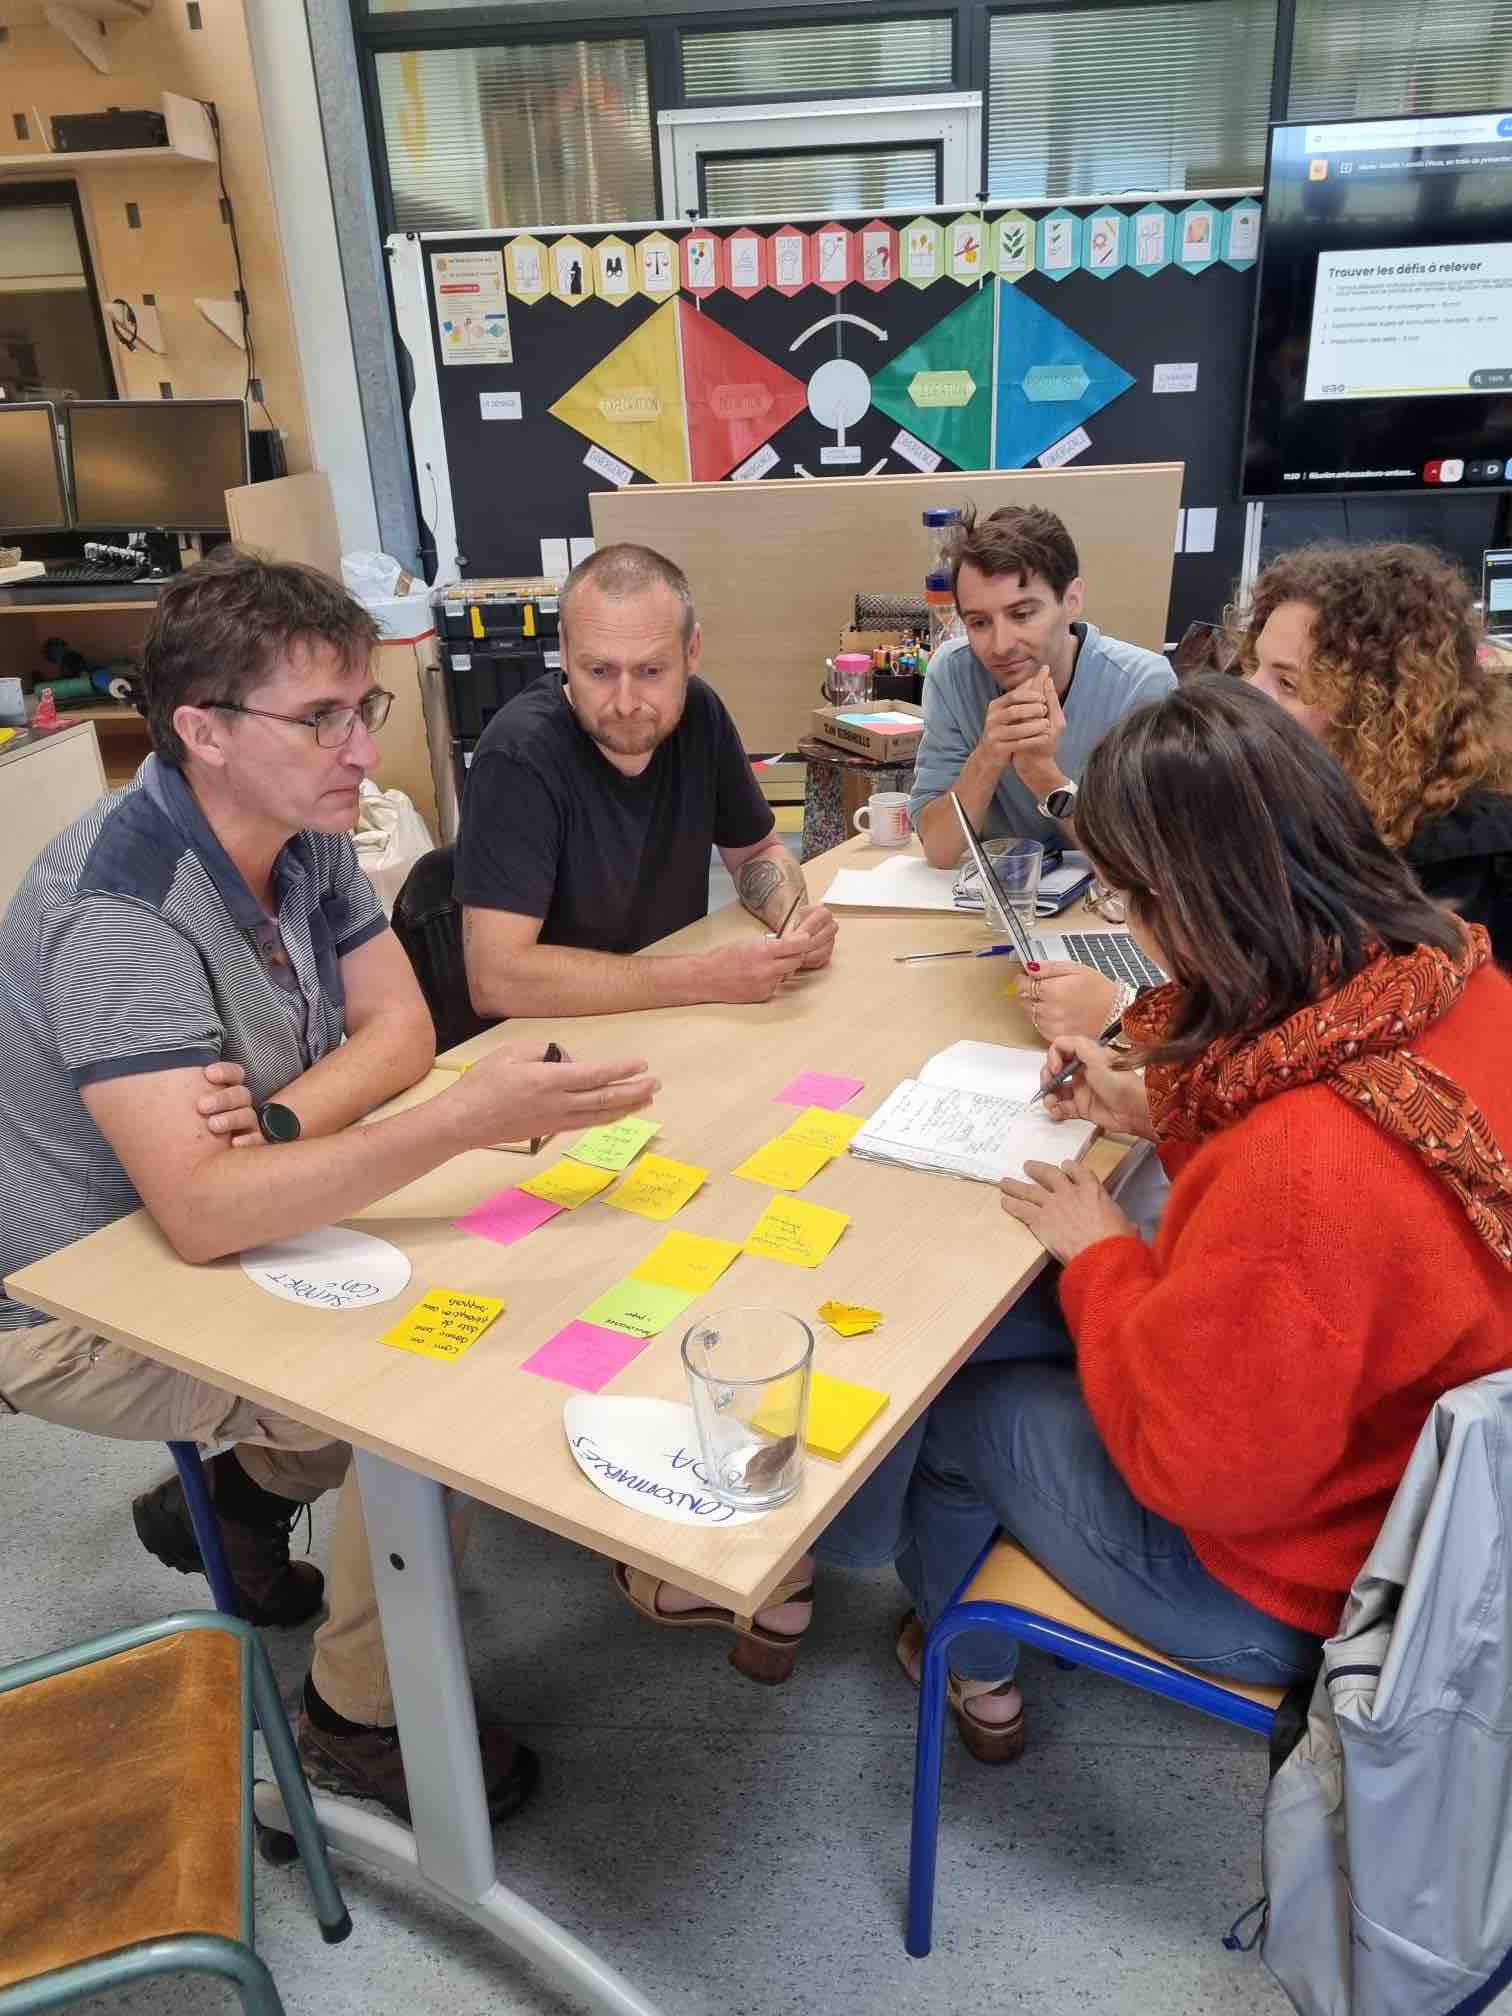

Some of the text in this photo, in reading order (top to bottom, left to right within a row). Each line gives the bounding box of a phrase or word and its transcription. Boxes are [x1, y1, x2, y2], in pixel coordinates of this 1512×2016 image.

[1328, 261, 1483, 279] Trouver les défis à relever
